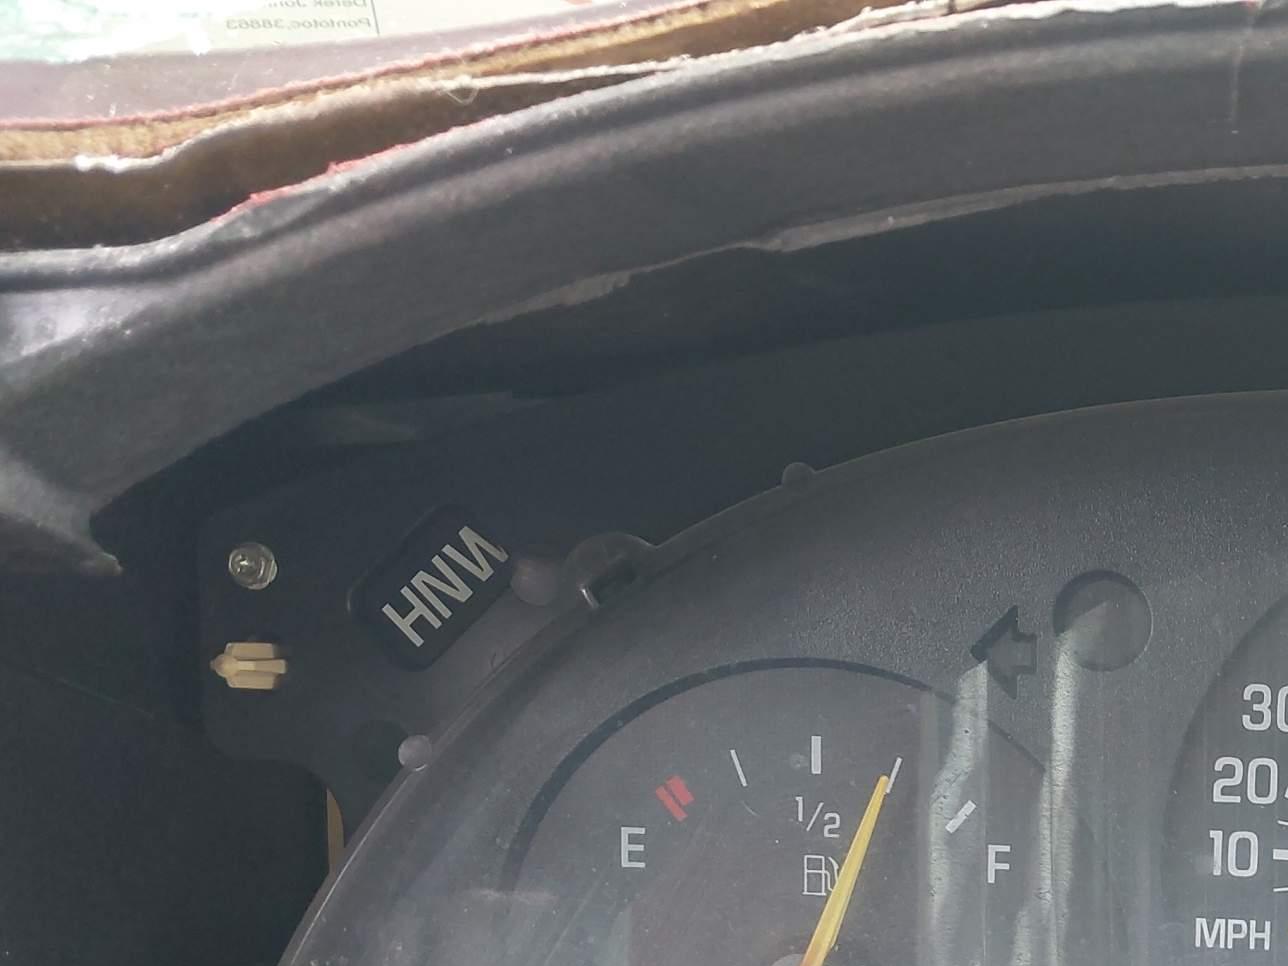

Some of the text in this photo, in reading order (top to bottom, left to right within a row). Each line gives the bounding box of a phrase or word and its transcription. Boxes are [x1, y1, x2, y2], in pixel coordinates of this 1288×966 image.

[1212, 756, 1278, 804] 20
[620, 827, 646, 868] E
[987, 844, 1012, 884] F
[1210, 830, 1259, 878] 10
[1195, 917, 1271, 951] MPH
